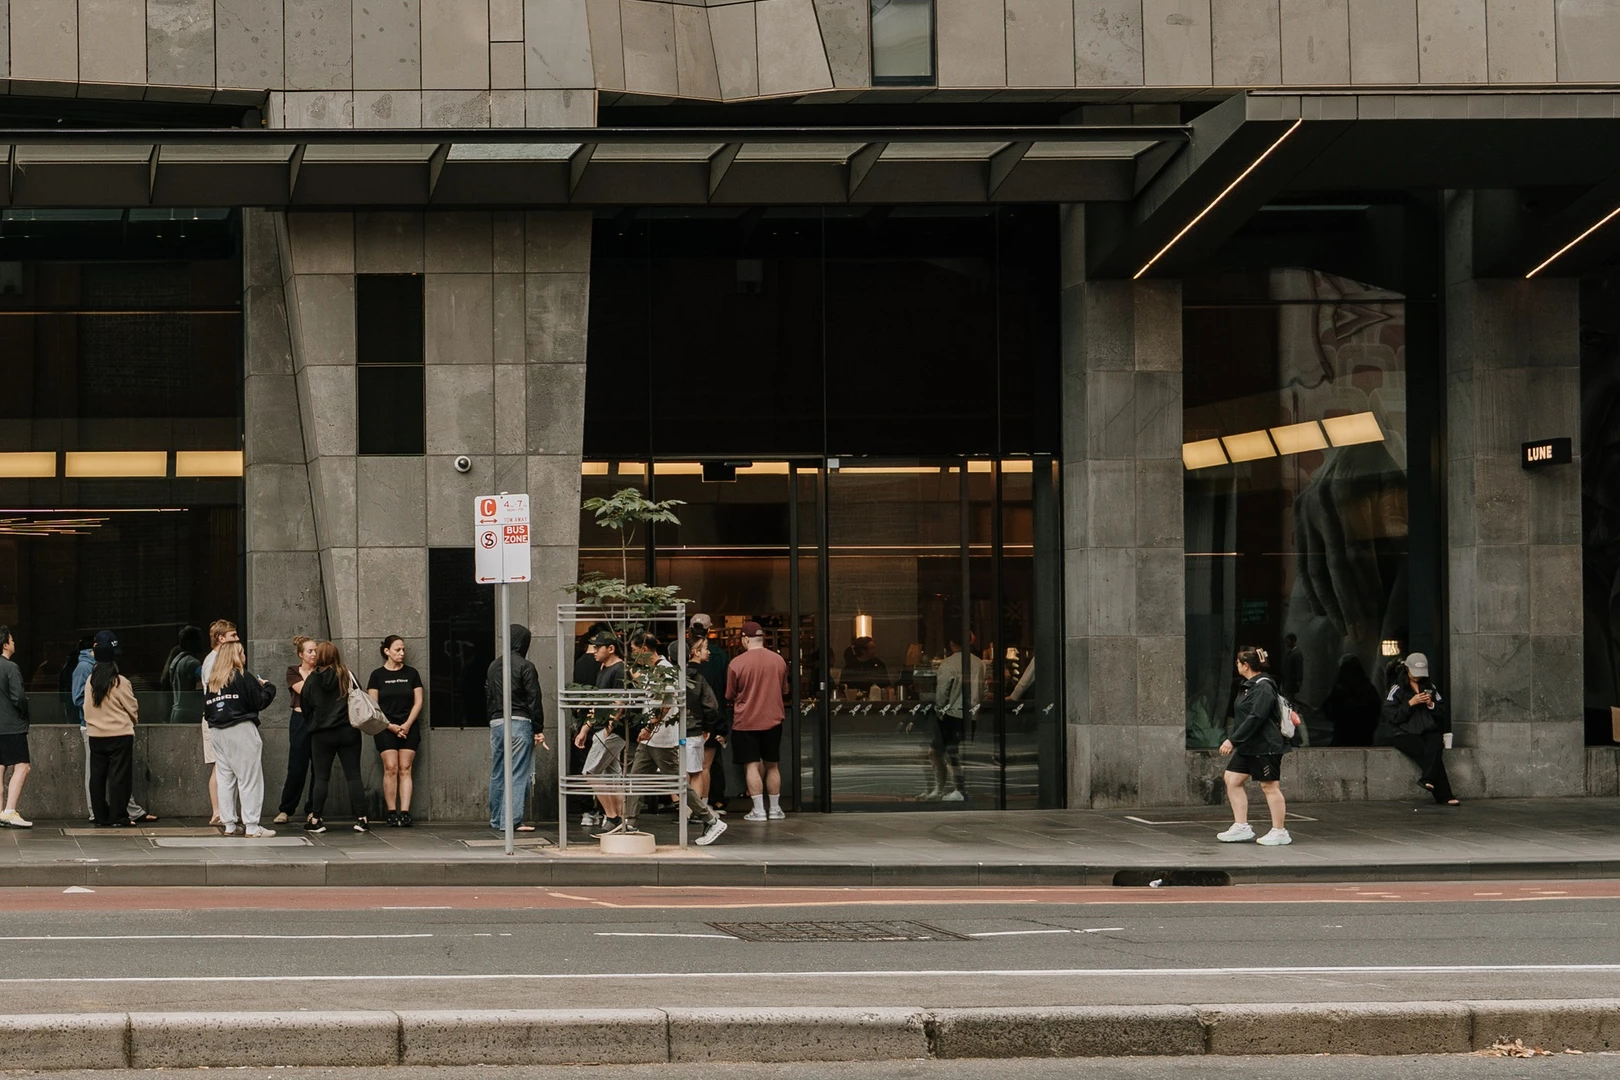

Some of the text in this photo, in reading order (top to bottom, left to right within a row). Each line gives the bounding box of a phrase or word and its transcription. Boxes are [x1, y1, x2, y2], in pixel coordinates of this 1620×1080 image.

[1527, 445, 1553, 461] LUNE
[484, 500, 492, 515] C
[506, 526, 525, 534] BUS
[504, 535, 528, 544] ZONE
